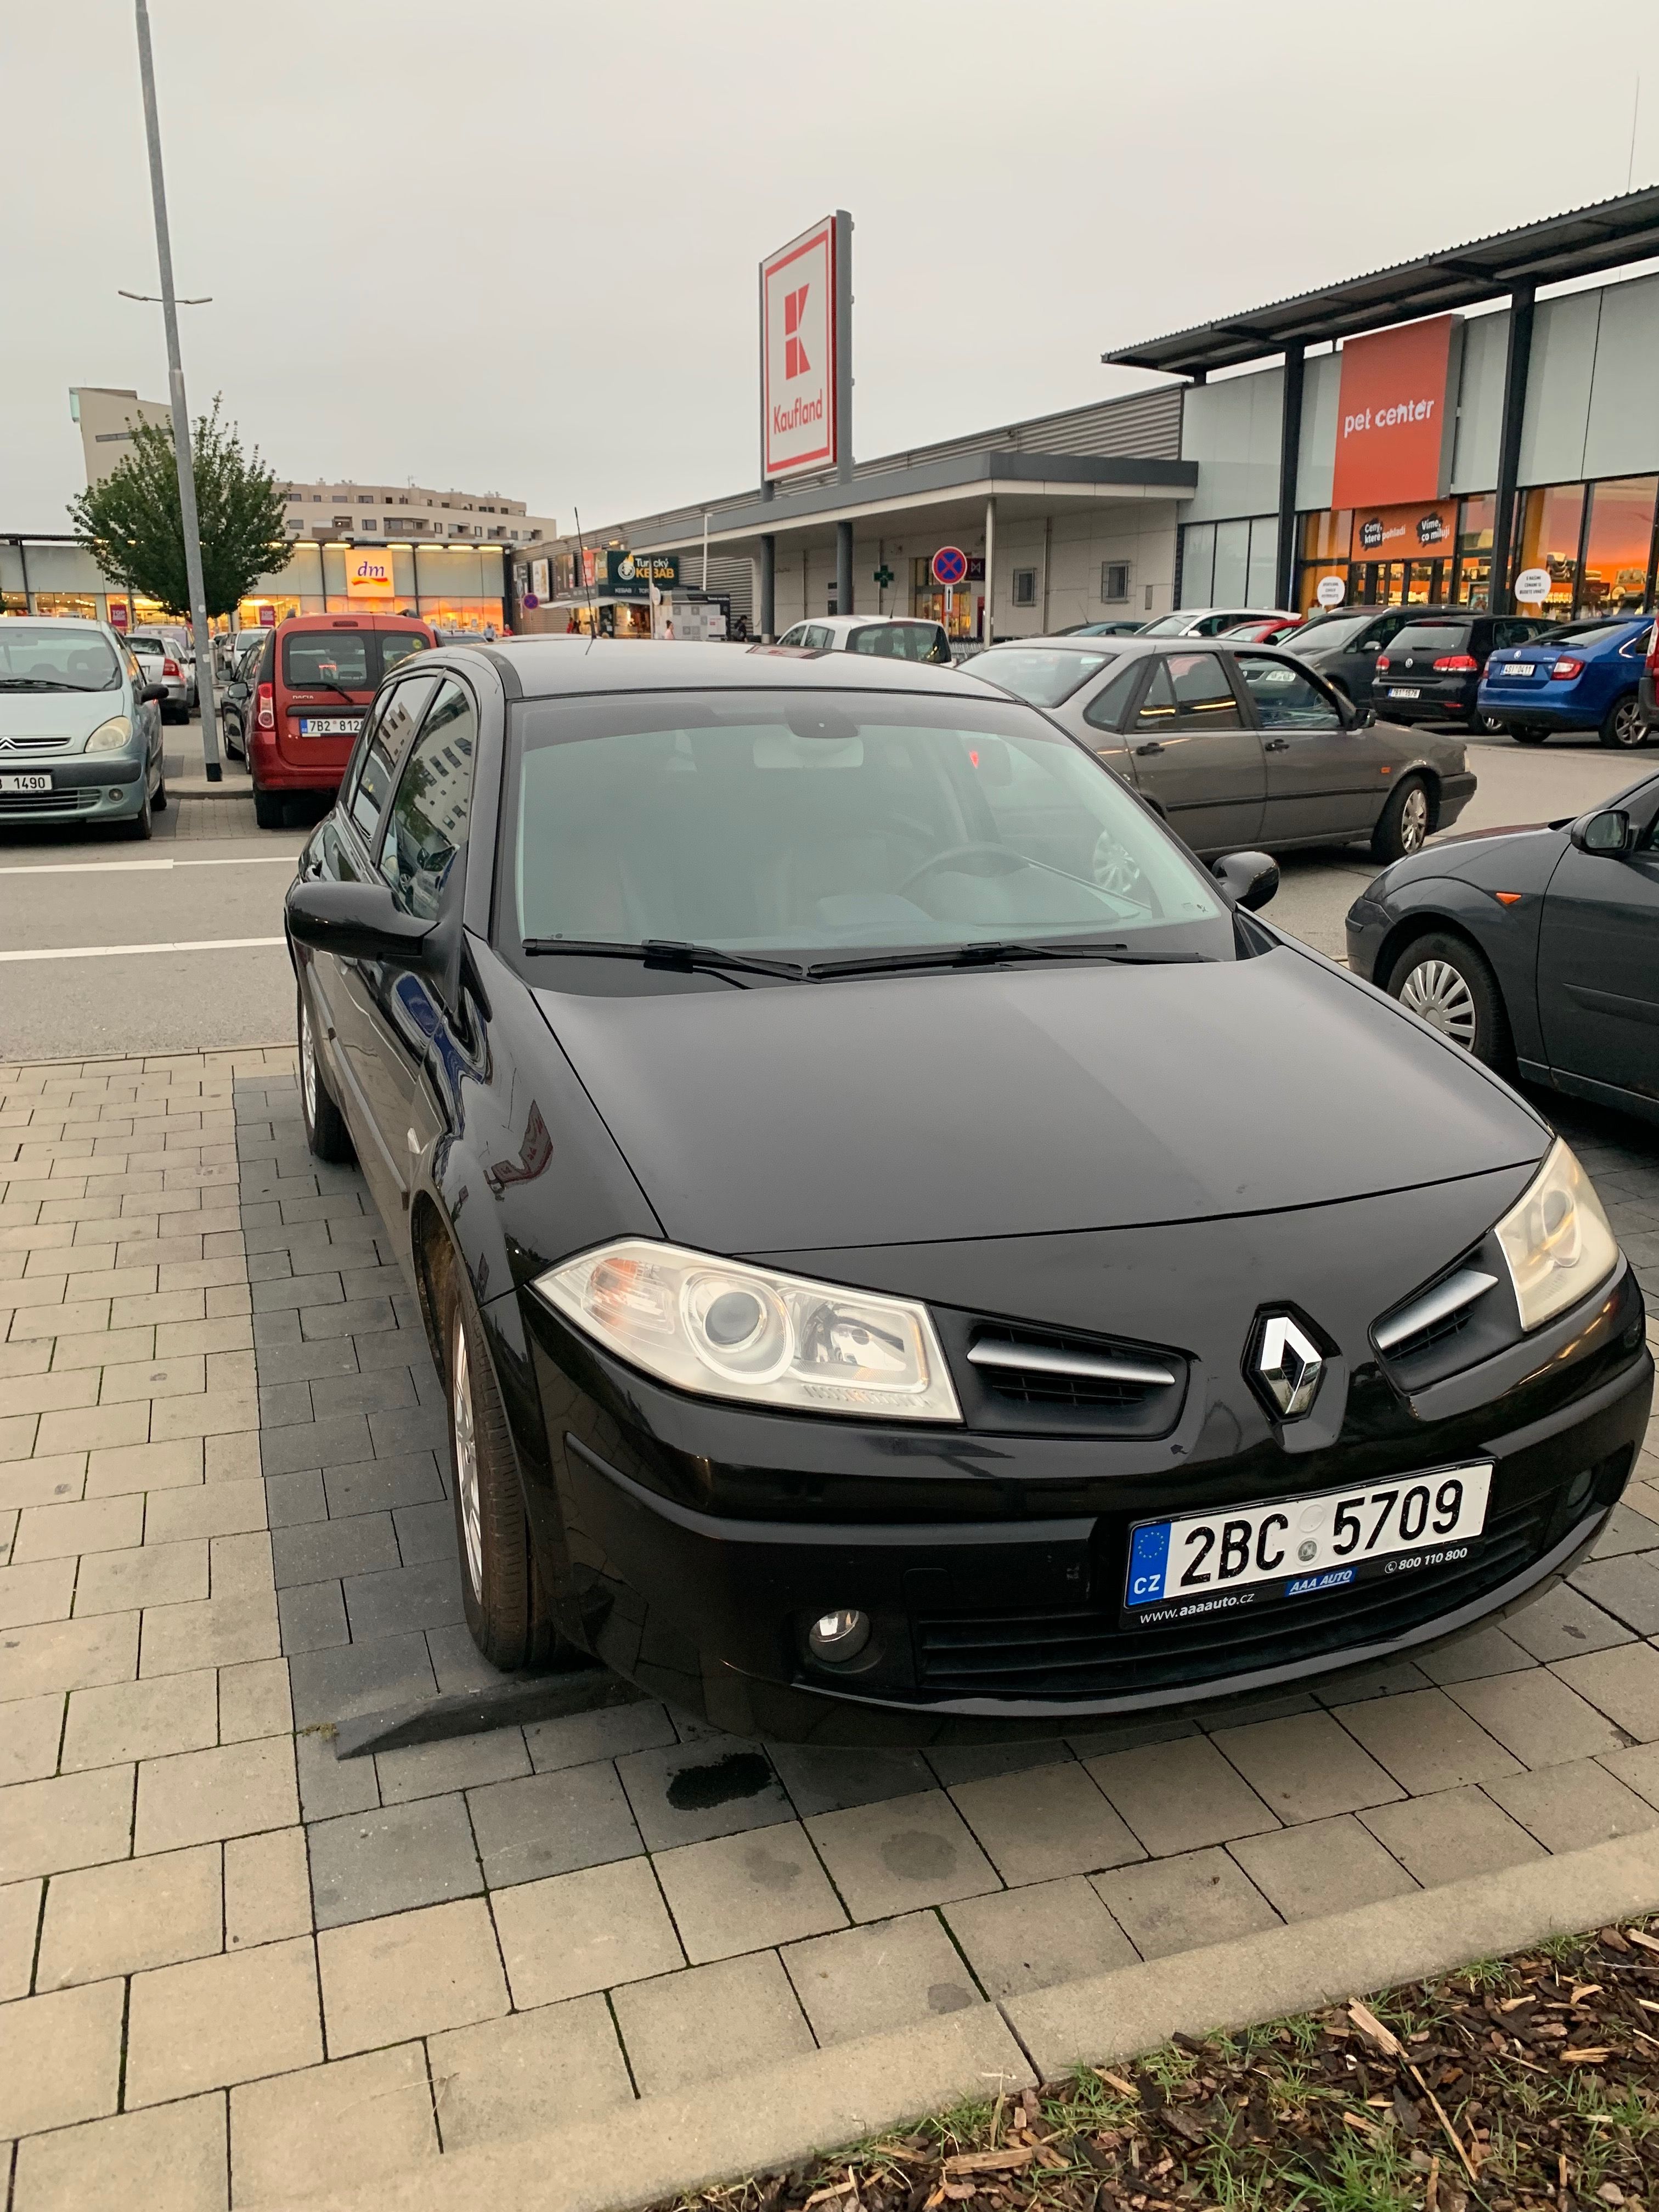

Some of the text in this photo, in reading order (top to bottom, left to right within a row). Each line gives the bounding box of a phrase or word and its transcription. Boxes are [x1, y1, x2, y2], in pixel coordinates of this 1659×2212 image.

[774, 388, 822, 435] Kaufland
[1344, 399, 1435, 438] pet center
[1365, 523, 1383, 533] Ceny,
[1421, 533, 1430, 541] co
[358, 561, 385, 577] dm
[635, 557, 669, 568] Turcký
[310, 721, 330, 731] 7B2
[14, 777, 45, 789] 1490
[1180, 1479, 1464, 1587] 2BC 5709
[1399, 1548, 1468, 1570] 800 110 800
[1134, 1574, 1161, 1594] CZ
[1290, 1570, 1353, 1593] AAA AUTO
[1140, 1593, 1255, 1624] www.aaaauto.cz
